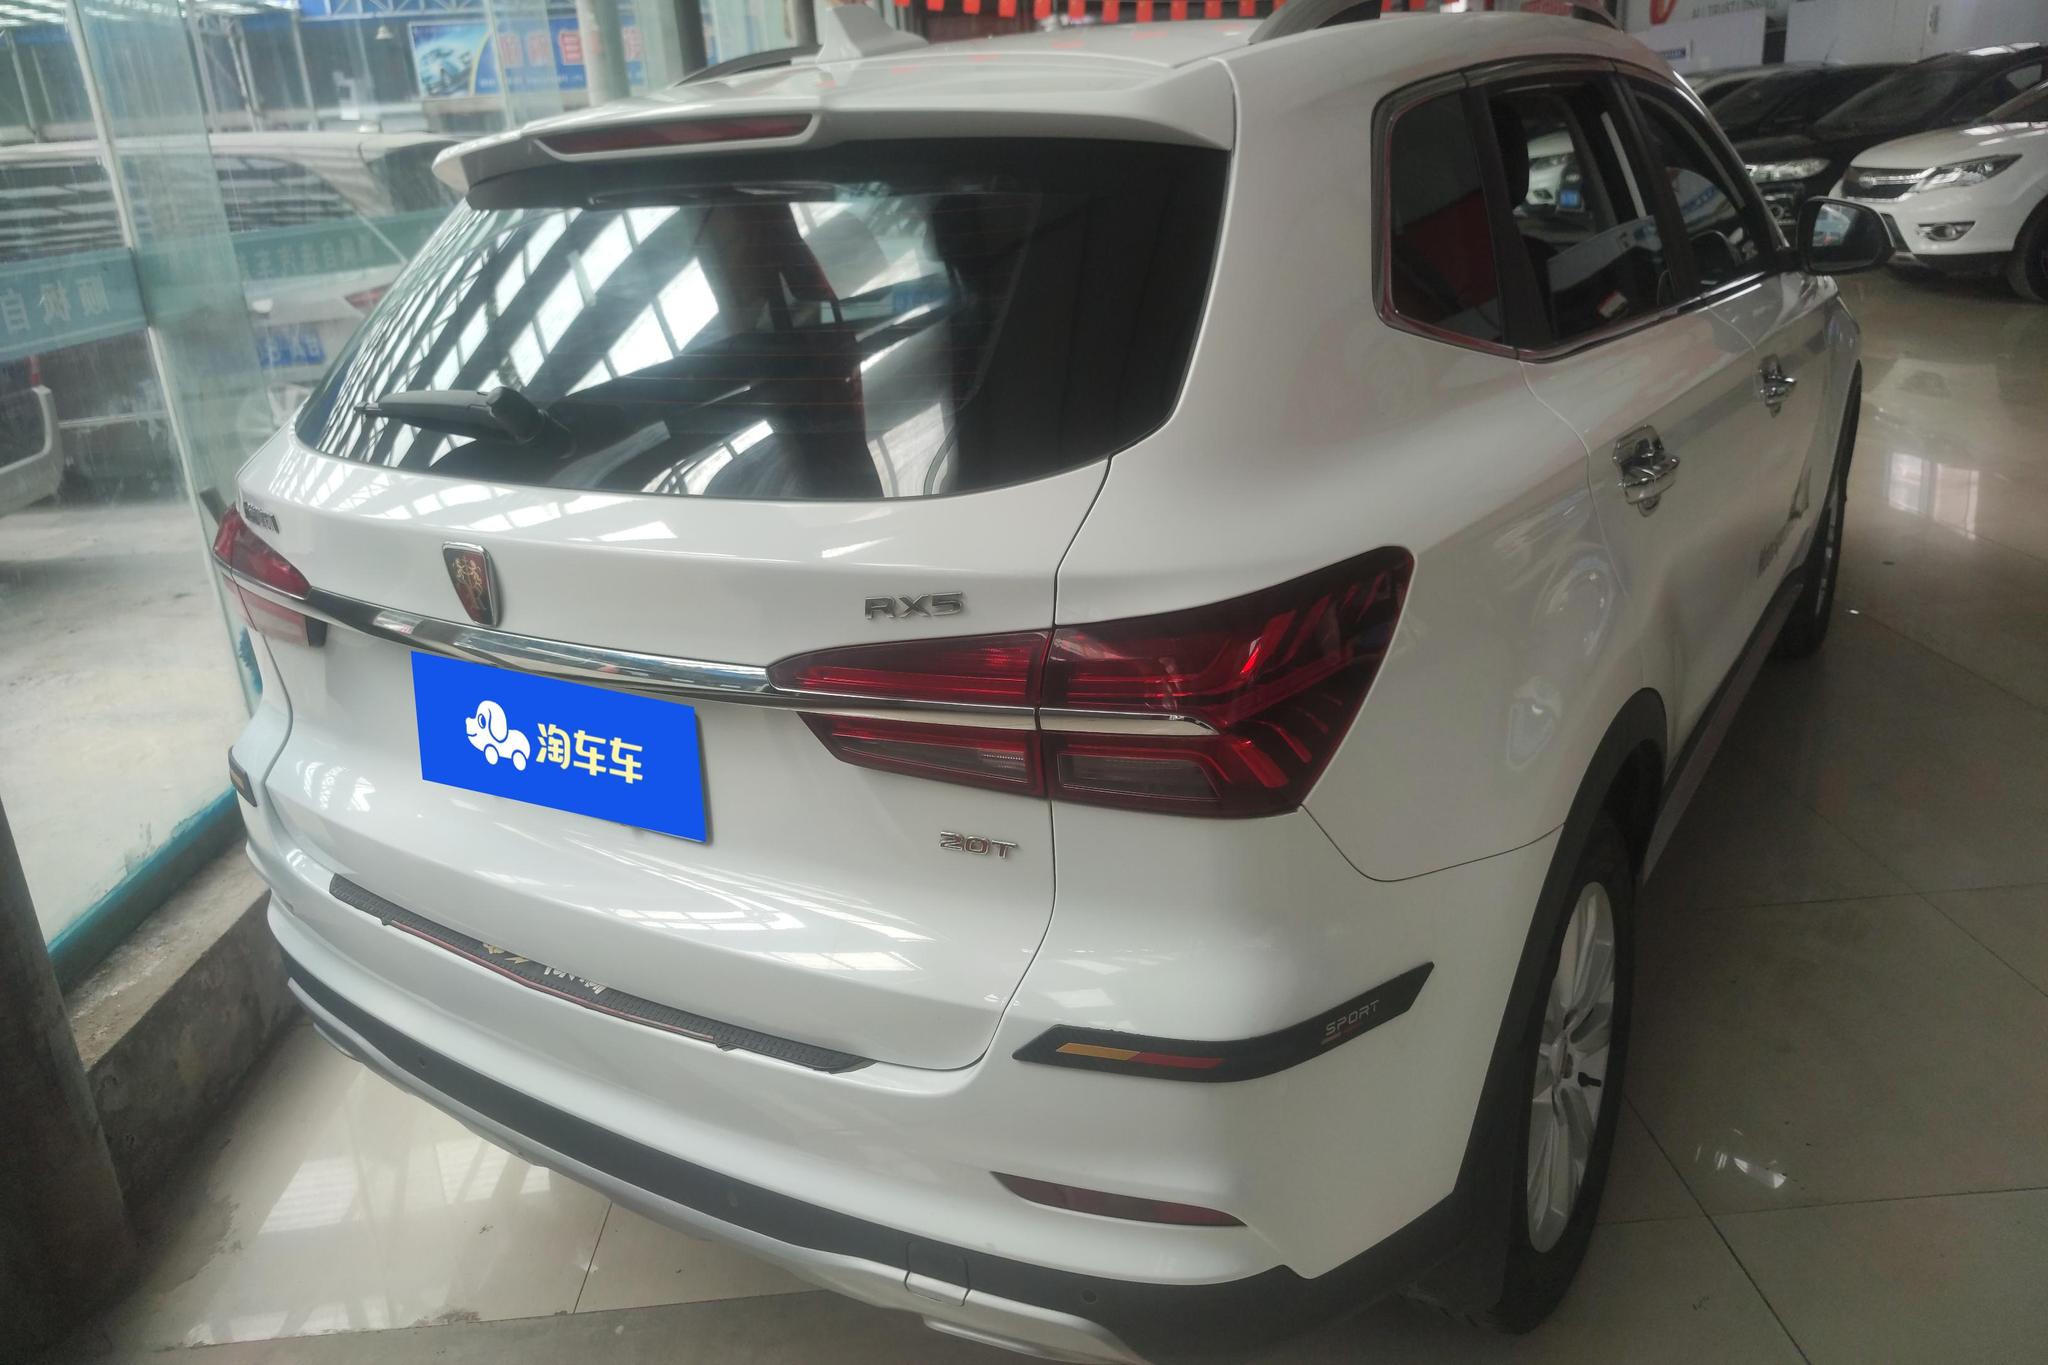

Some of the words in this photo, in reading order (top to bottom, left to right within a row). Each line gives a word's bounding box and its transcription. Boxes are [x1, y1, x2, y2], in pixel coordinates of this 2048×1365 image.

[864, 592, 964, 620] RX5
[940, 831, 1018, 860] 20T
[1325, 999, 1379, 1036] SPORT
